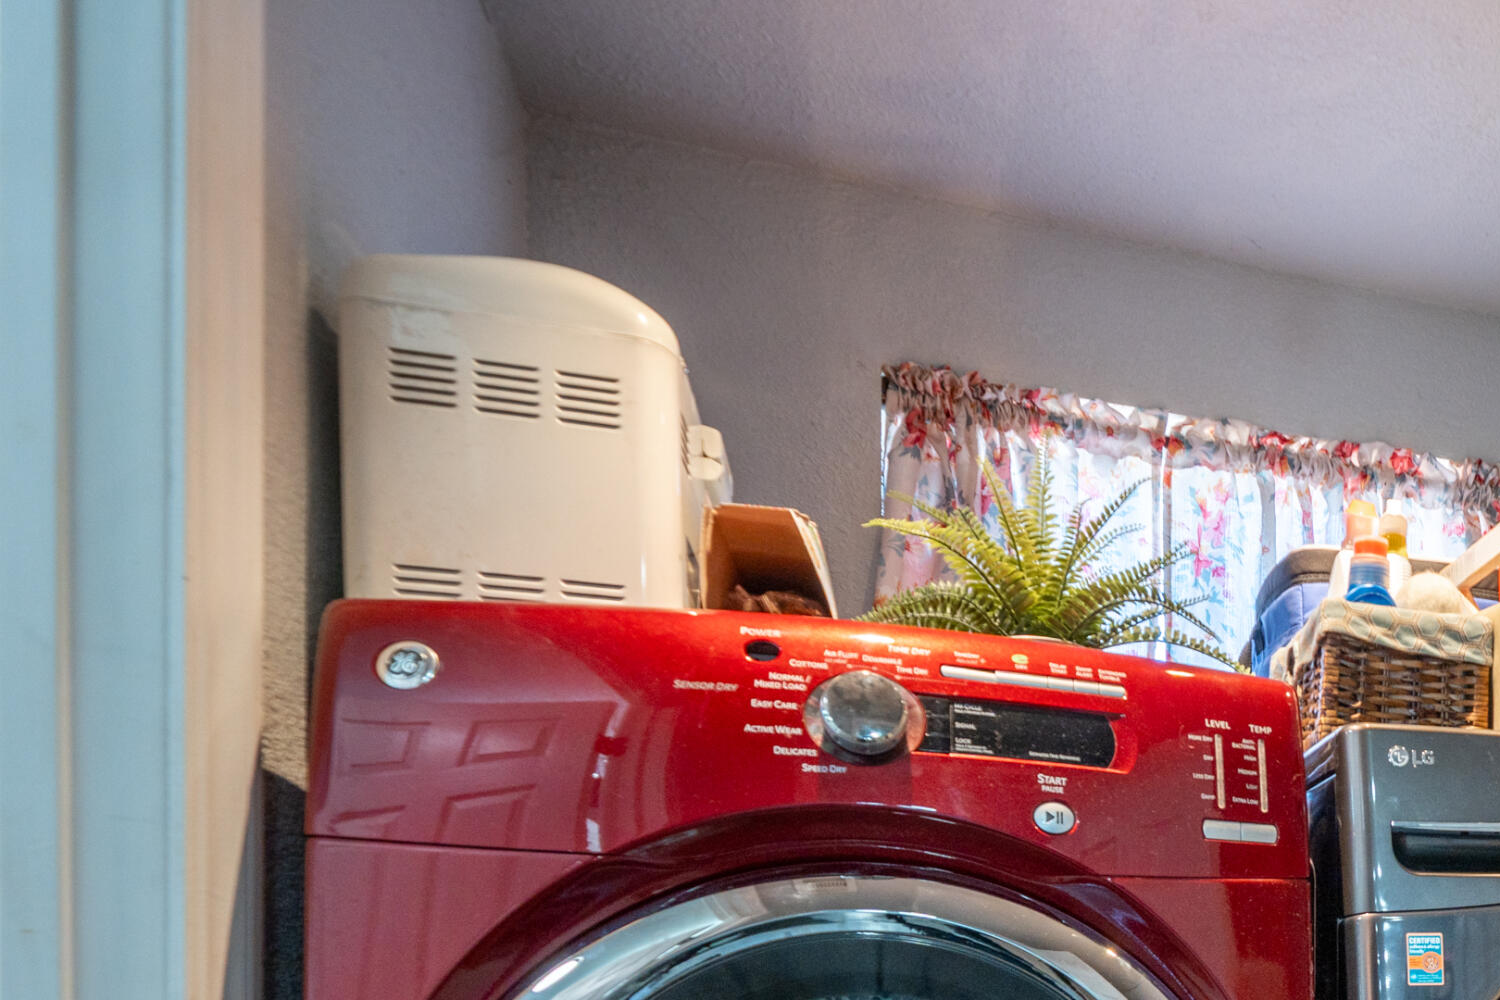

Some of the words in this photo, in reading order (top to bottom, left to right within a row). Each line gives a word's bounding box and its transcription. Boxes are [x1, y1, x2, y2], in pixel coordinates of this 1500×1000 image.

[739, 625, 782, 638] POWER
[750, 698, 773, 708] EASY
[774, 700, 799, 711] CARE
[1204, 718, 1232, 731] LEVEL
[1248, 723, 1273, 735] TEMP
[773, 745, 818, 757] DELICATES
[1412, 749, 1435, 768] LG
[1037, 773, 1067, 787] START
[1041, 785, 1064, 794] PAUSE
